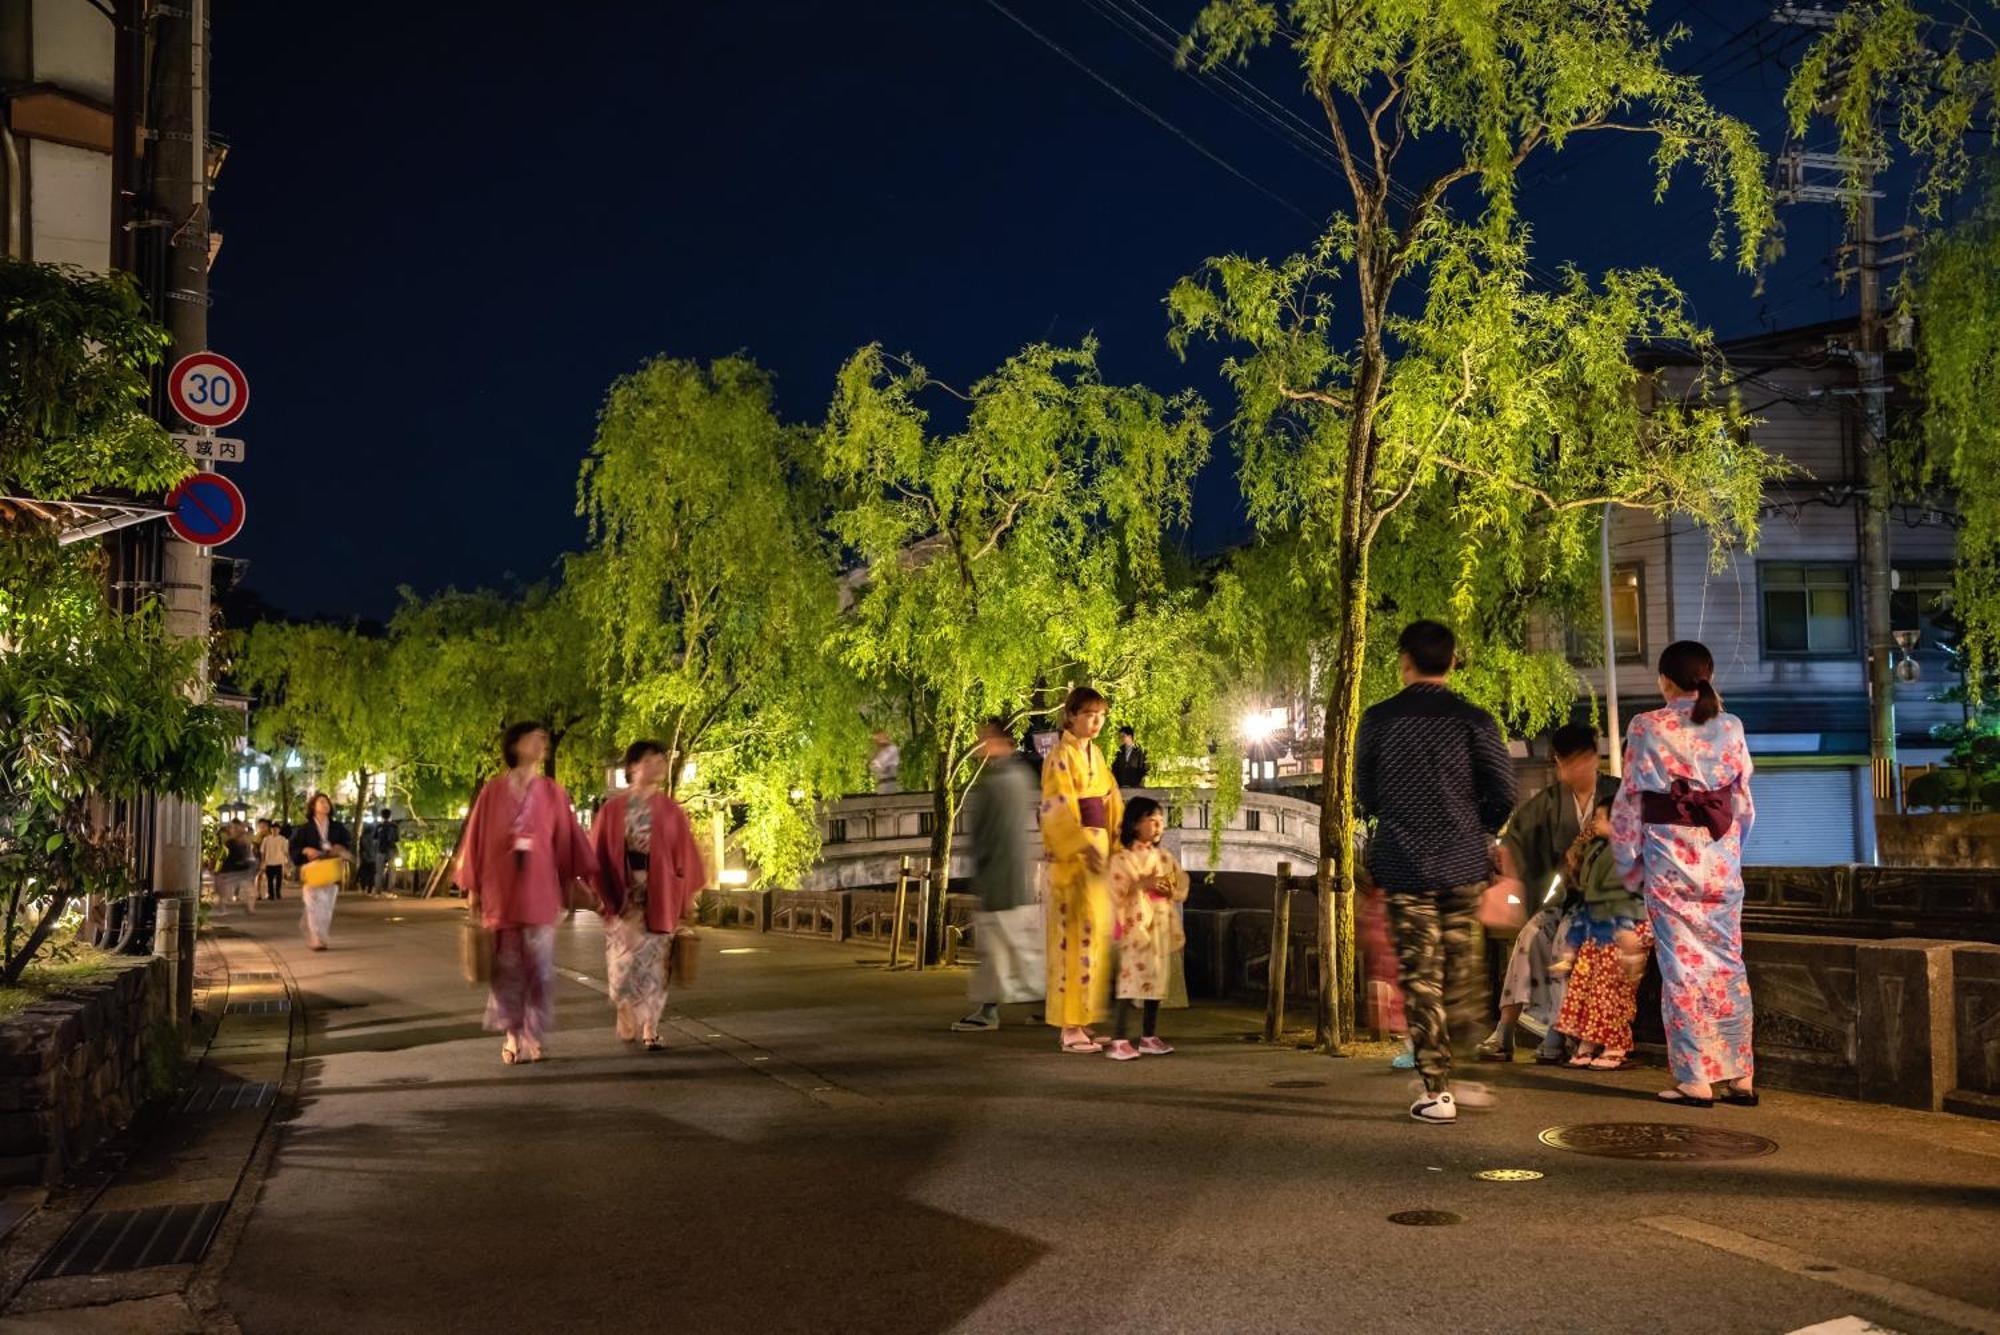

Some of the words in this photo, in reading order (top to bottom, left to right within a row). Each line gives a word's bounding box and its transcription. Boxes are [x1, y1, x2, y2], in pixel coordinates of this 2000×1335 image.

[189, 374, 230, 406] 30
[172, 438, 236, 458] 区域内
